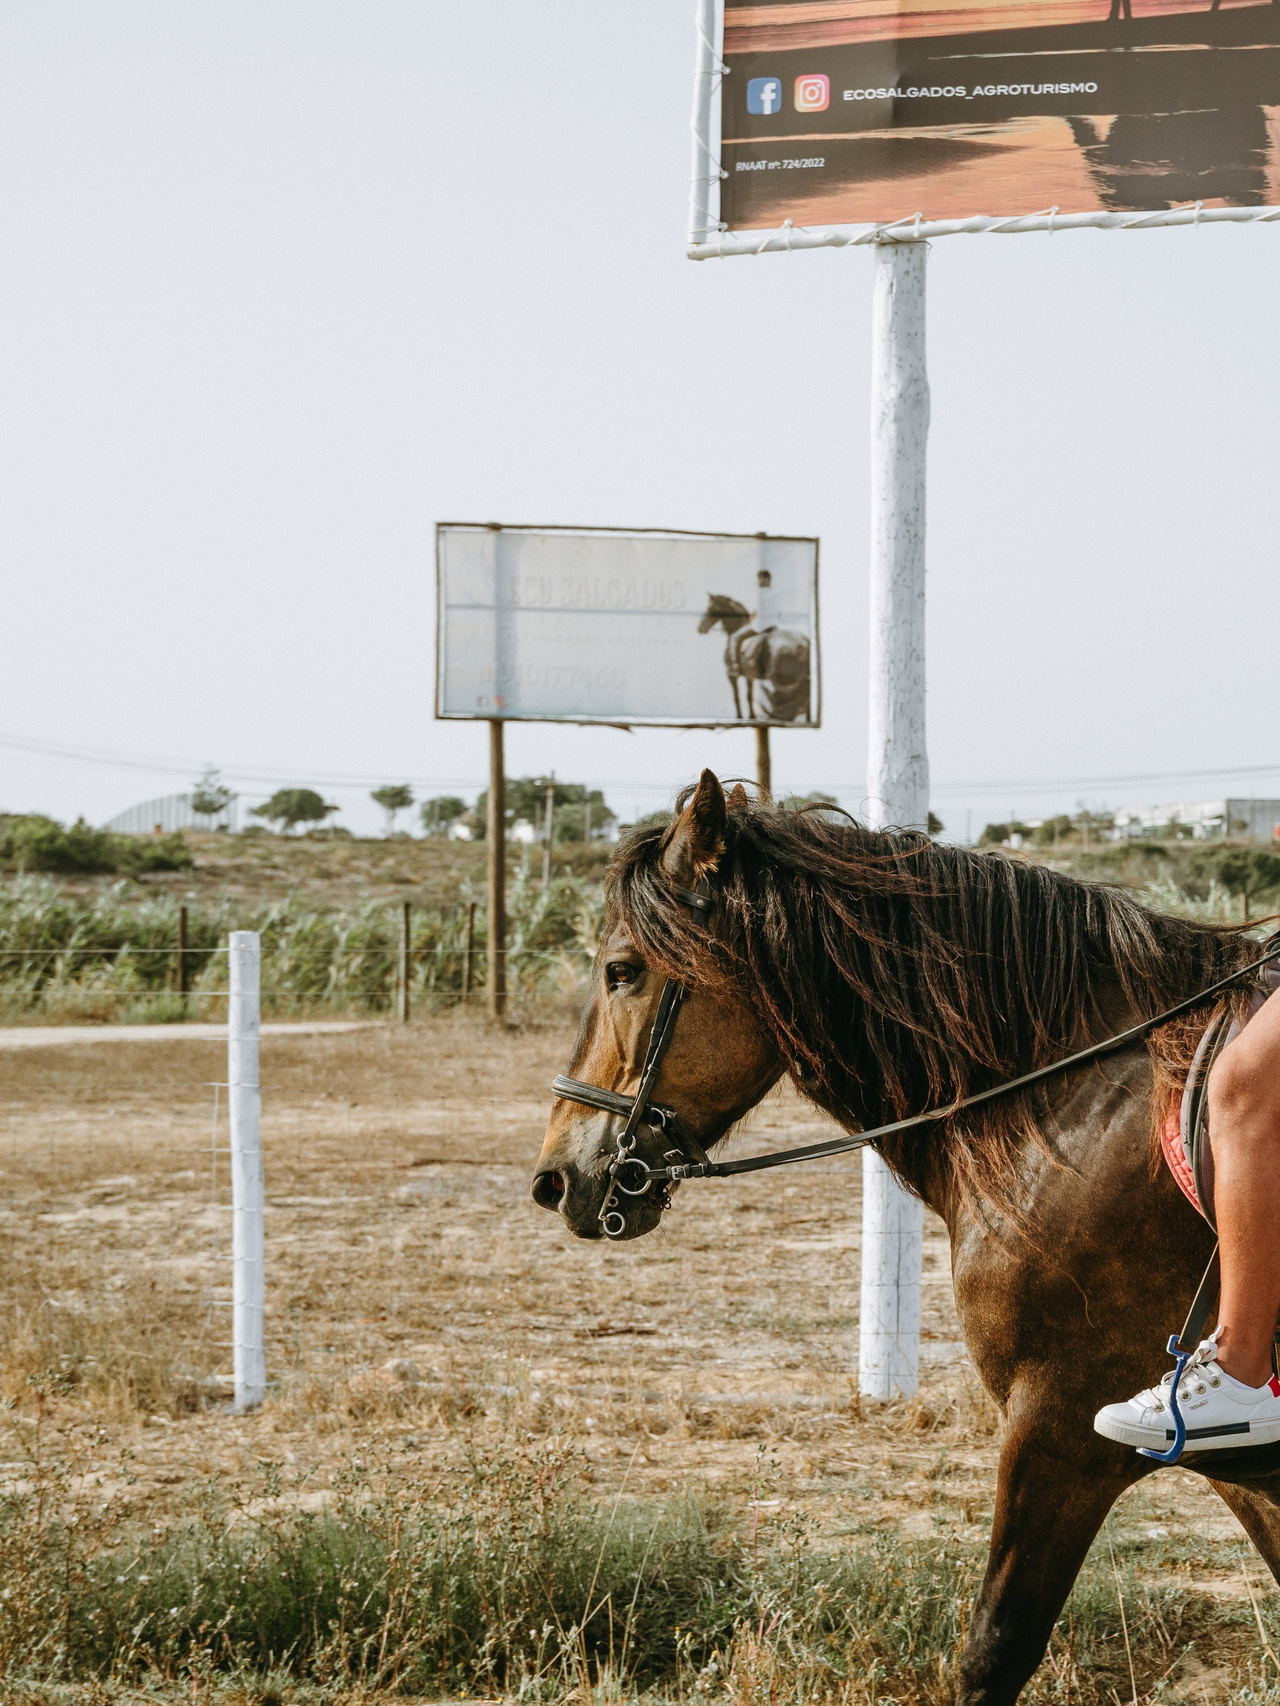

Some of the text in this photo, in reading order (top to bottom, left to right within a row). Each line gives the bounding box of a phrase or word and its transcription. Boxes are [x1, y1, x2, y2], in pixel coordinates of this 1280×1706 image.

[843, 82, 1098, 101] ECOSALGADOS_AGROTURISMO
[736, 161, 767, 171] RNAAT
[782, 158, 825, 169] 724/2022
